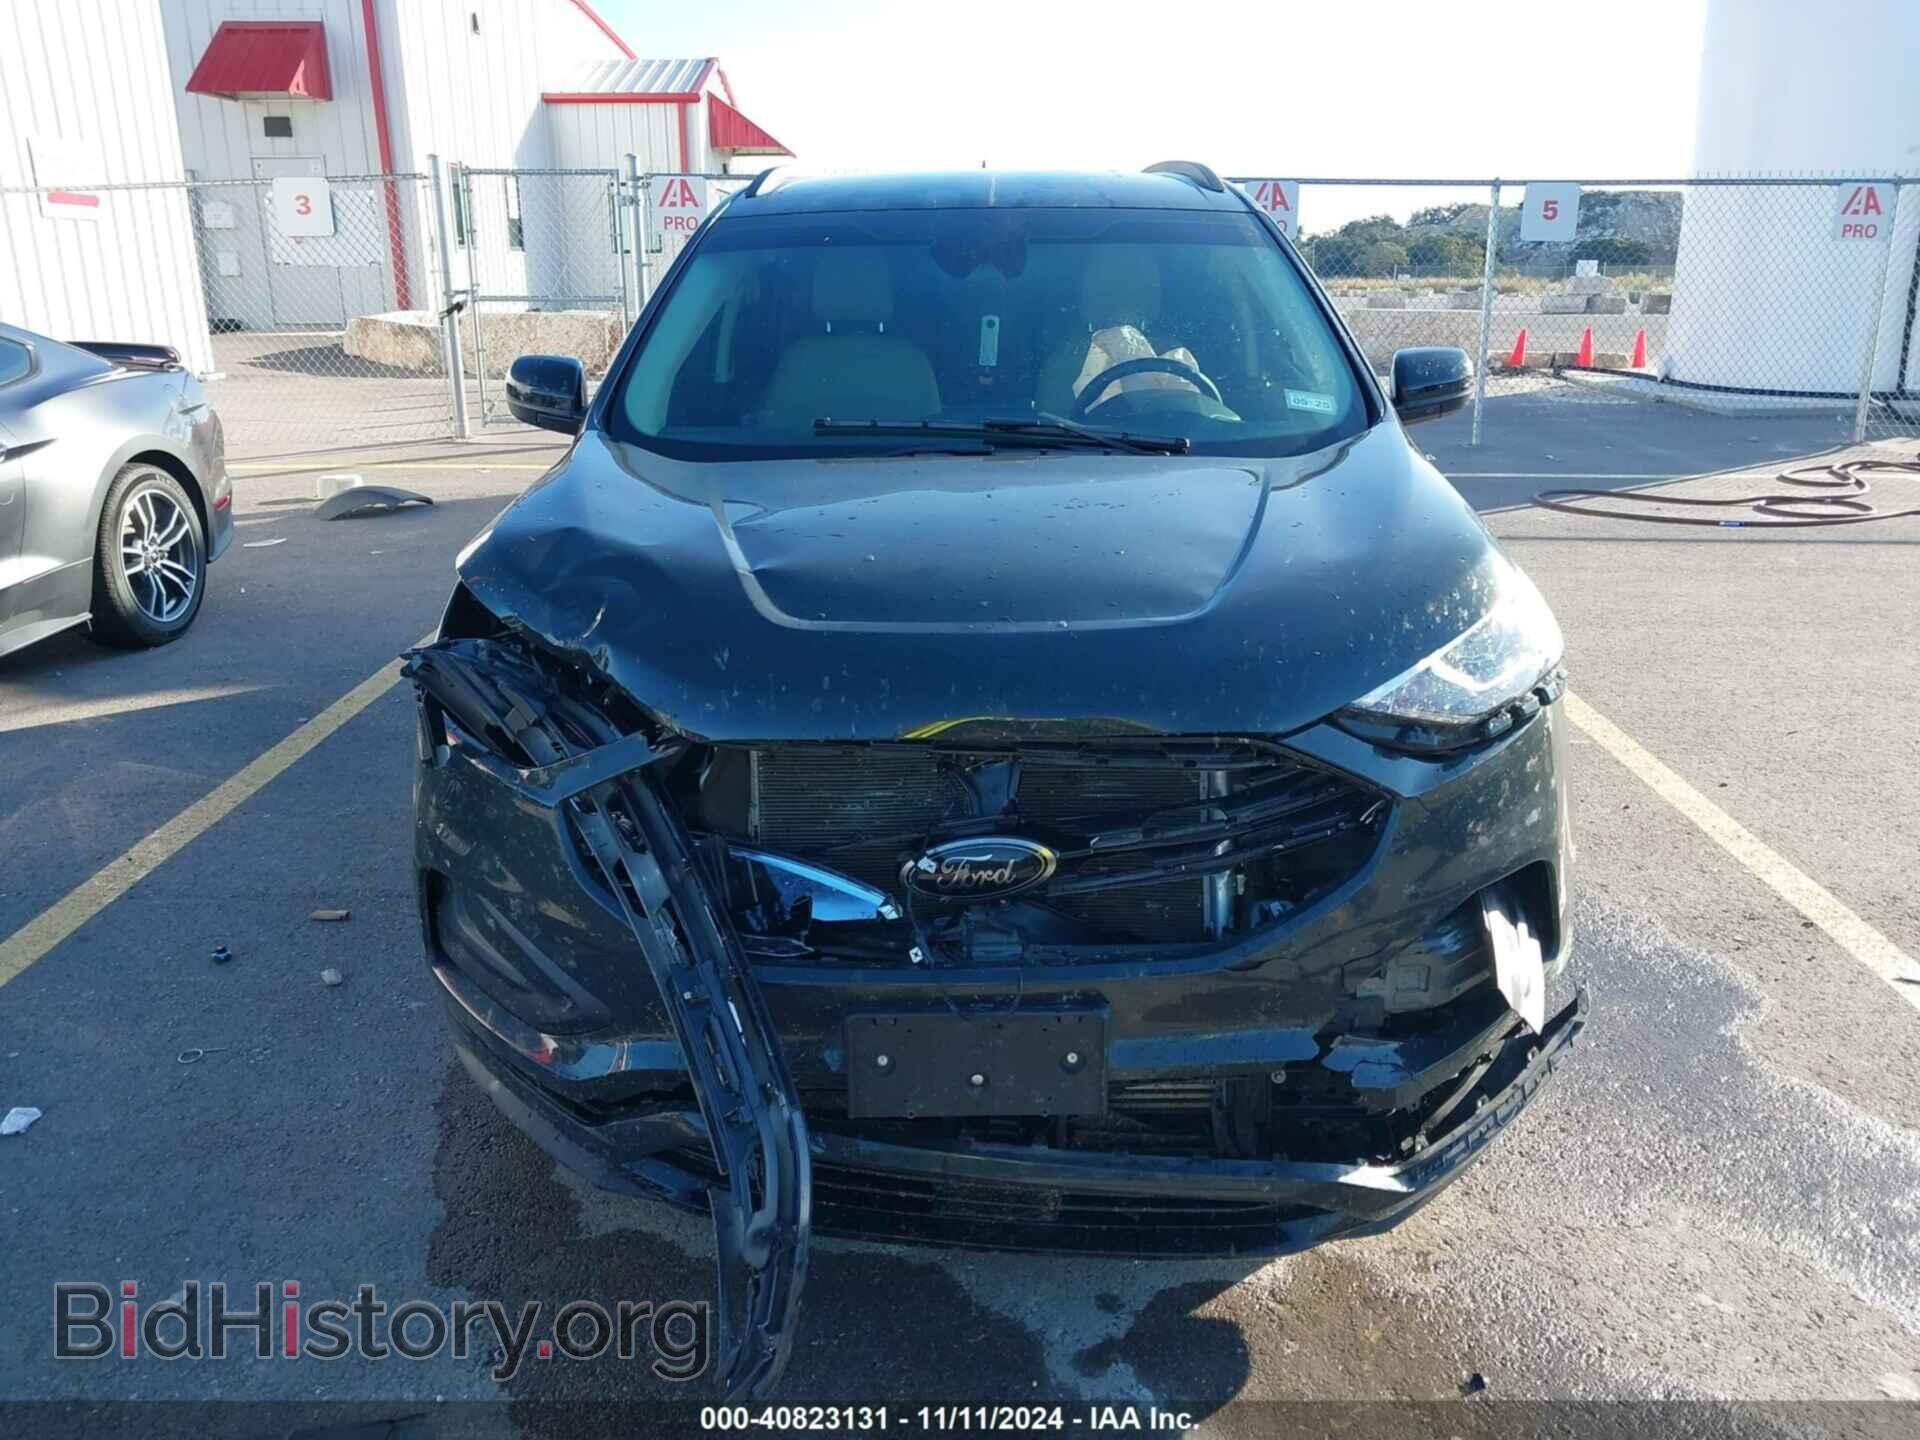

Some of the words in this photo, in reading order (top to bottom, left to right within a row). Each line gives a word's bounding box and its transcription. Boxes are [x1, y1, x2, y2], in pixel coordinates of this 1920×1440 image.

[294, 194, 312, 216] 3
[1543, 199, 1559, 221] 5
[663, 215, 699, 231] PRO
[1841, 223, 1878, 239] PRO
[936, 853, 1017, 889] Ford
